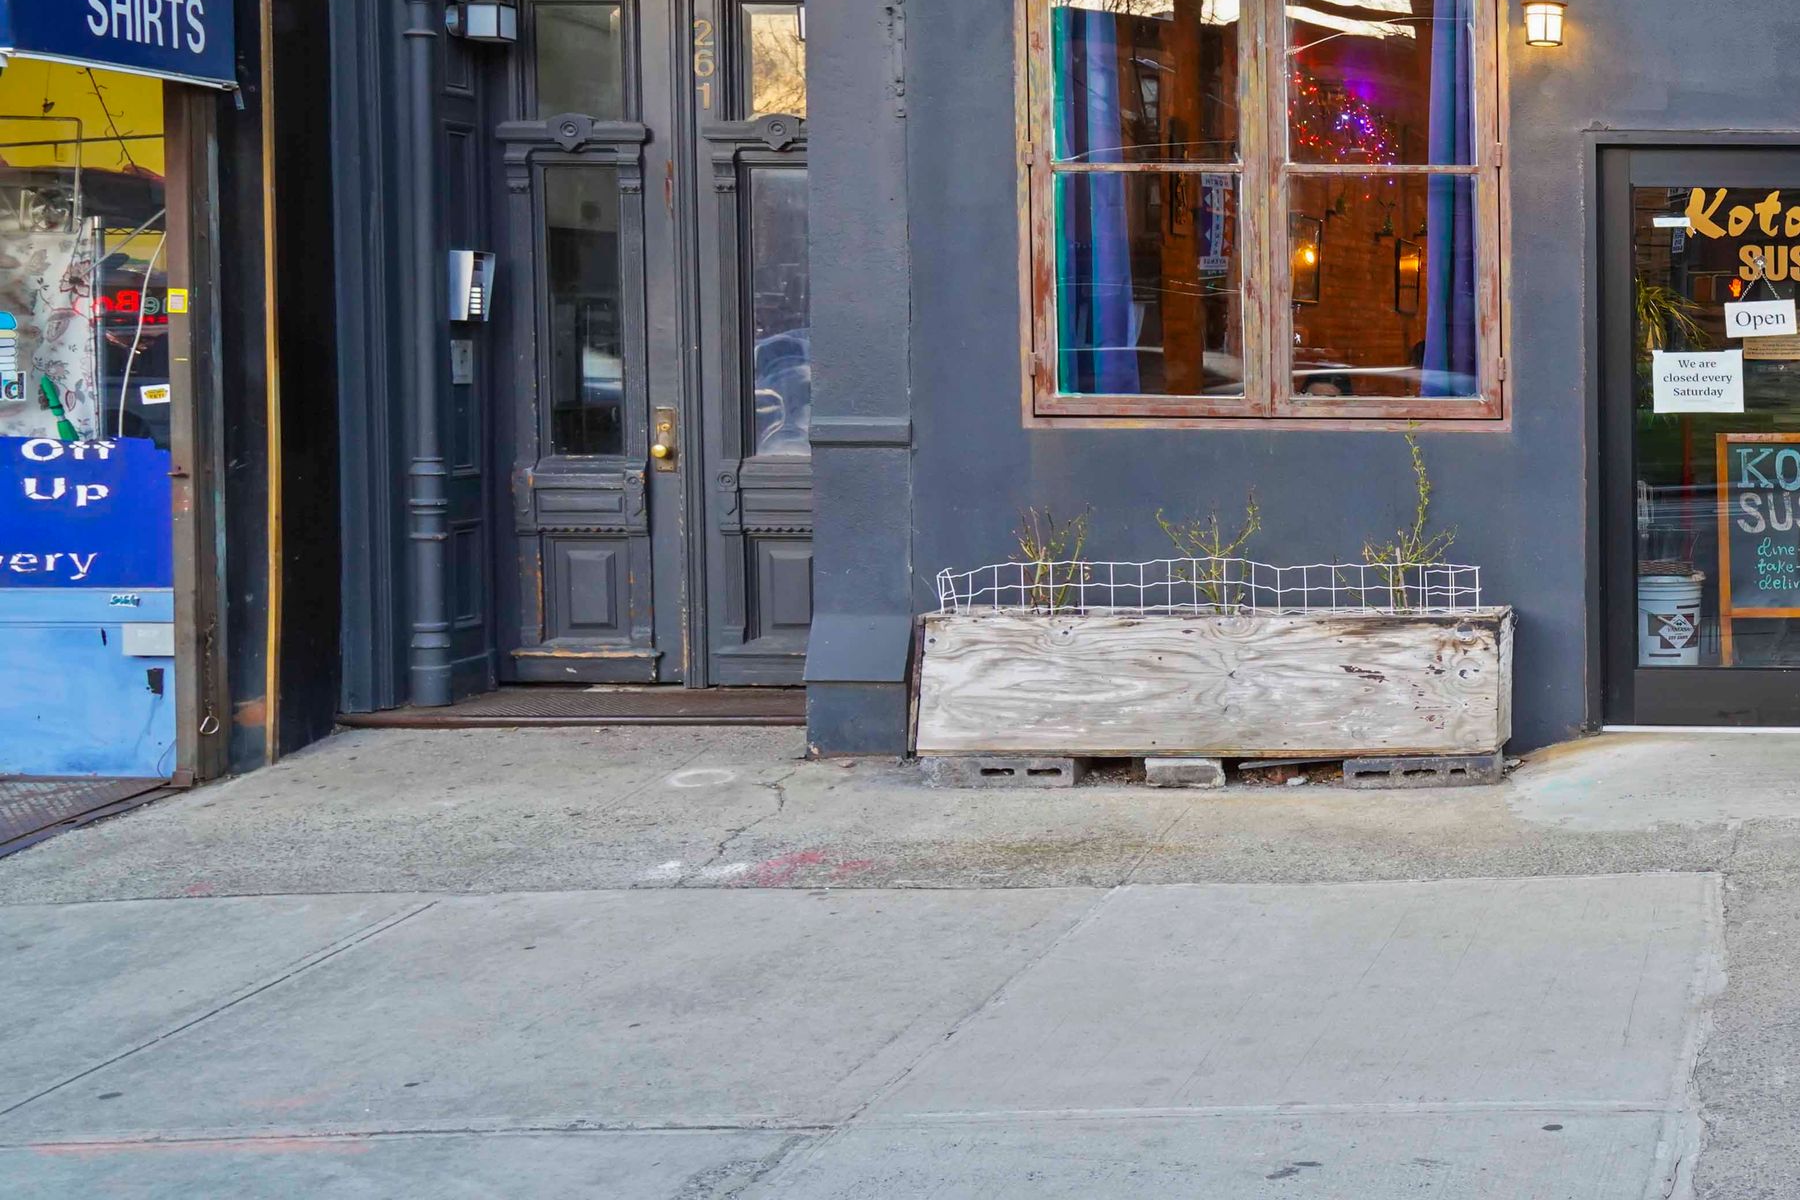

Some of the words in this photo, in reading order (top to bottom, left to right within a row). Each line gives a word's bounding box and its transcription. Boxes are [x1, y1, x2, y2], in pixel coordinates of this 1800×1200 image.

[693, 19, 715, 111] 261
[1735, 310, 1786, 330] Open
[1678, 360, 1696, 368] We
[1663, 373, 1699, 382] closed
[1702, 375, 1732, 384] every
[1673, 386, 1723, 397] Saturday
[20, 438, 116, 462] Off
[24, 477, 111, 507] Up
